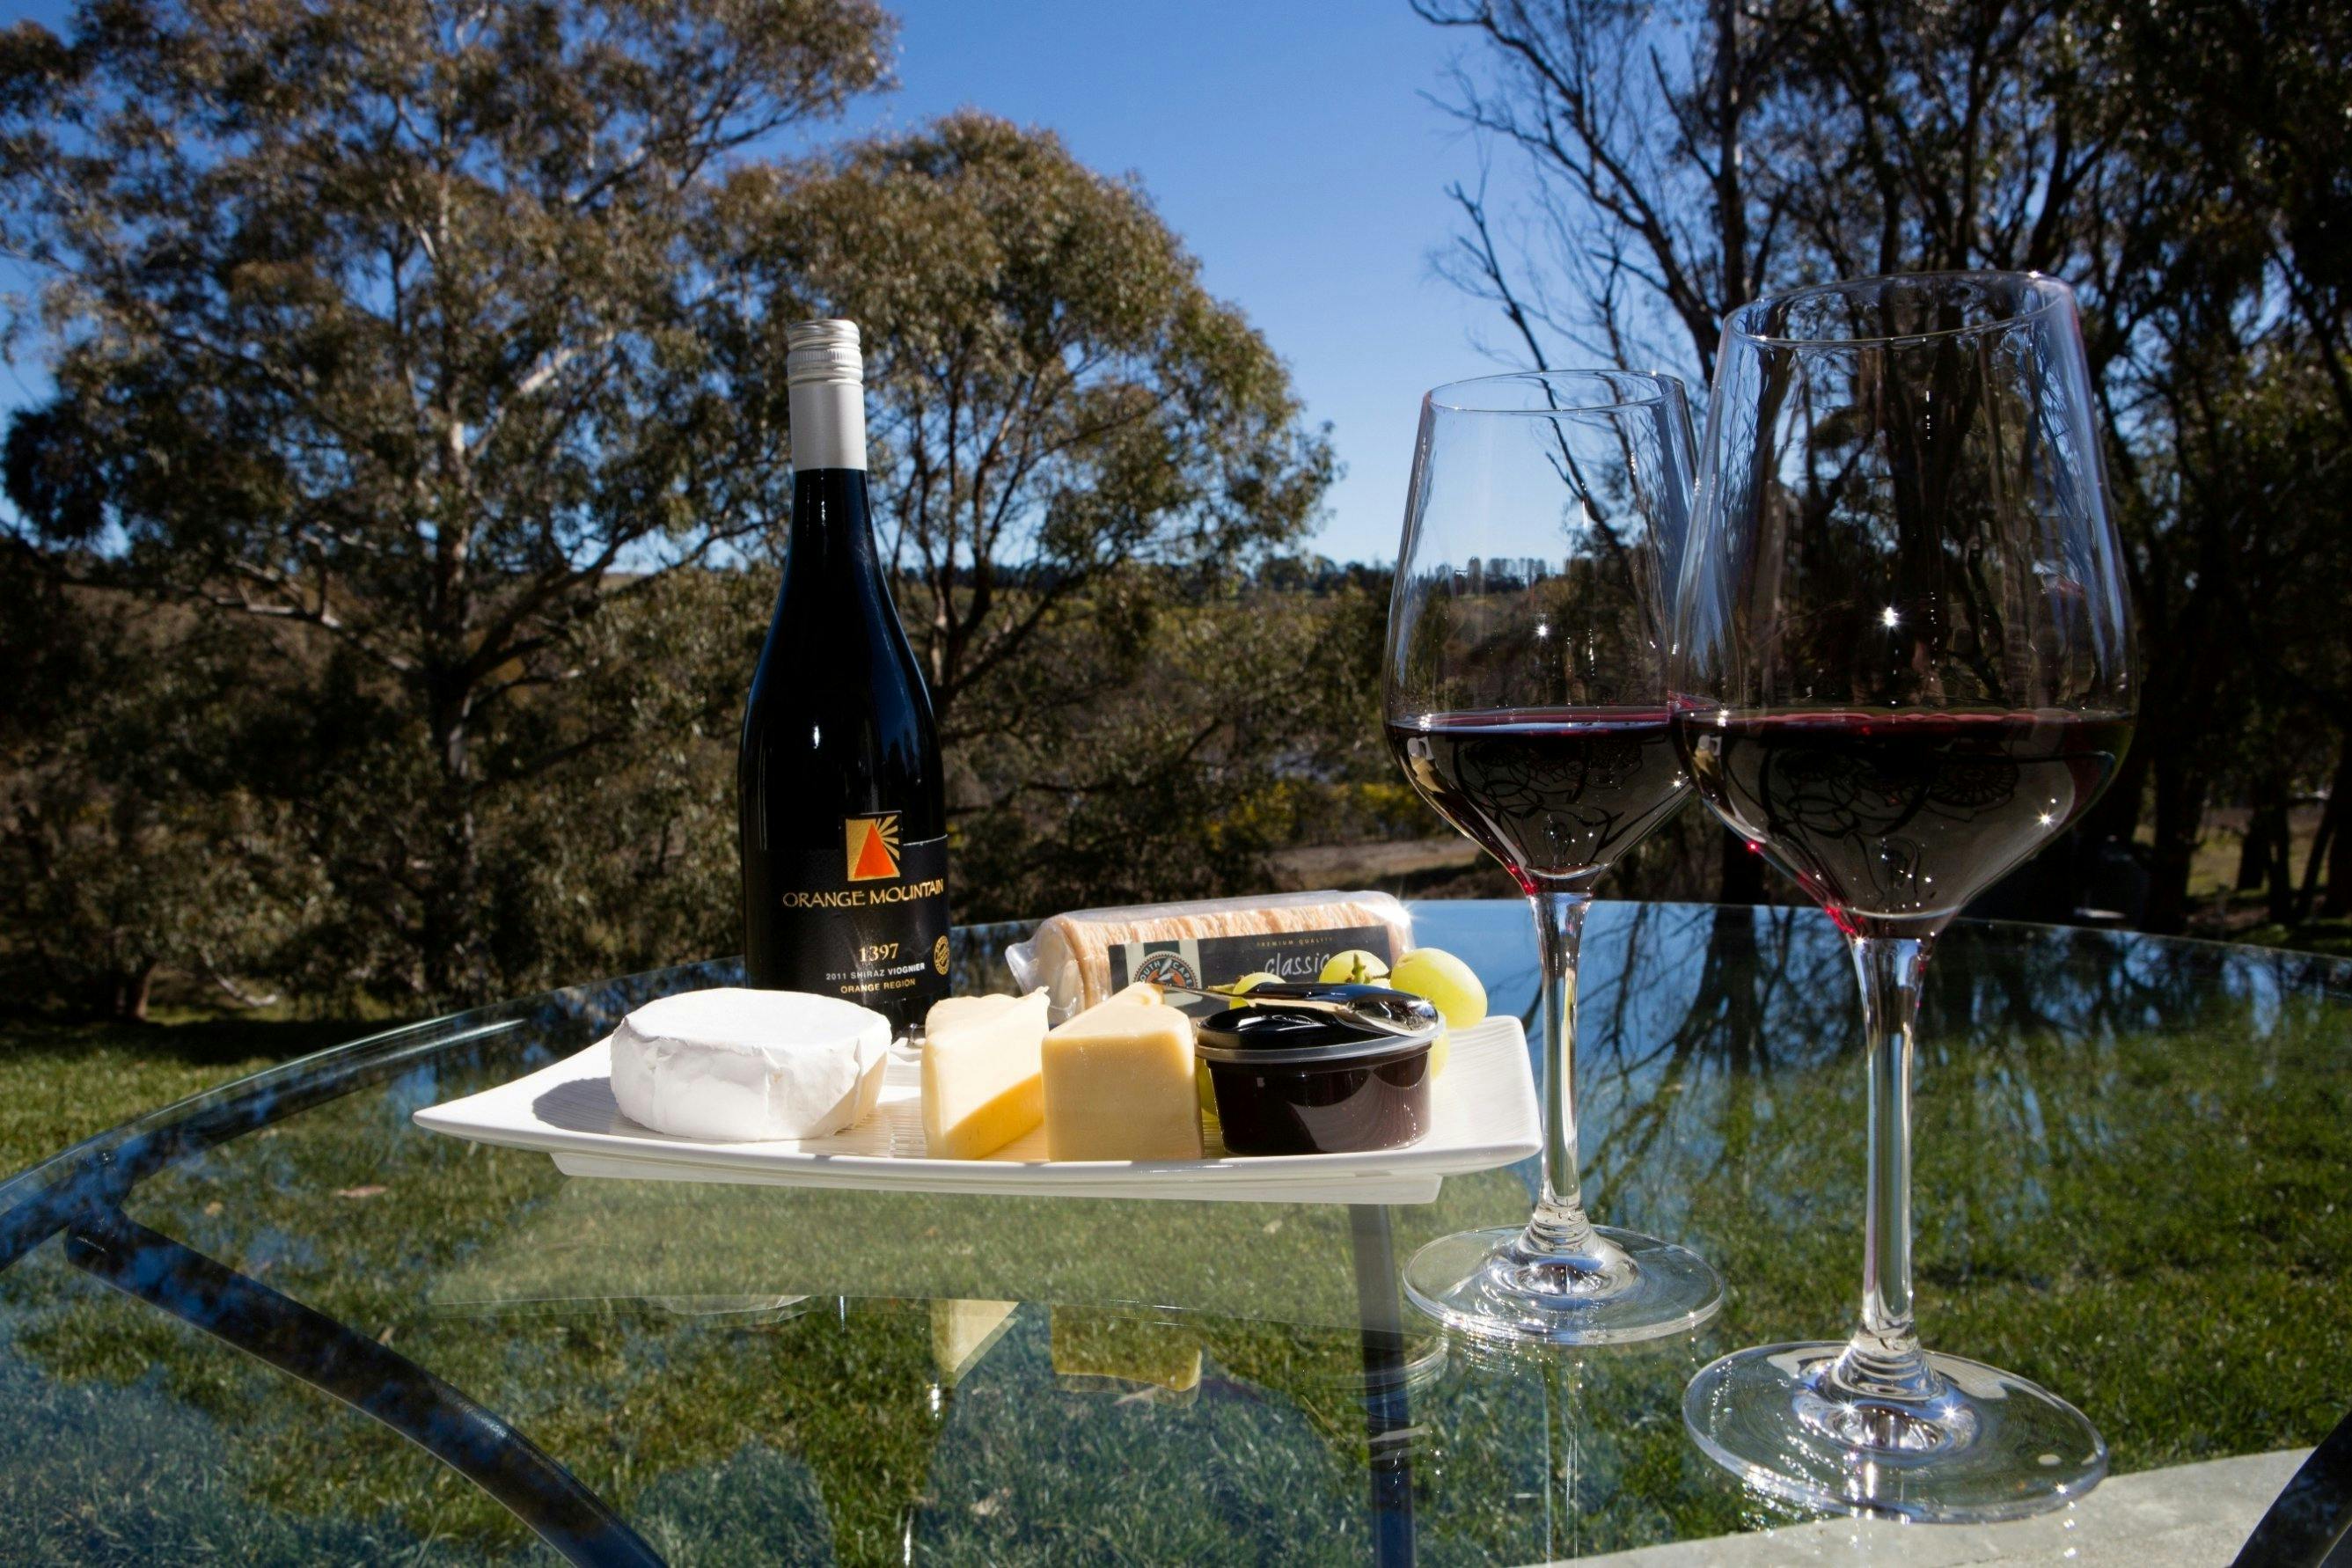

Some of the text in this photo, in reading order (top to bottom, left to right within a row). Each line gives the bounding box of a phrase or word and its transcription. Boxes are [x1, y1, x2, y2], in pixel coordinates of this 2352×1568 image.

[783, 878, 944, 908] ORANGE MOUNTAIN
[859, 942, 899, 963] 1397
[825, 963, 926, 981] 2011 SHIRAZ VIOGNIER
[1139, 960, 1192, 986] OUTH CAPE
[840, 978, 916, 994] ORANGE REGION
